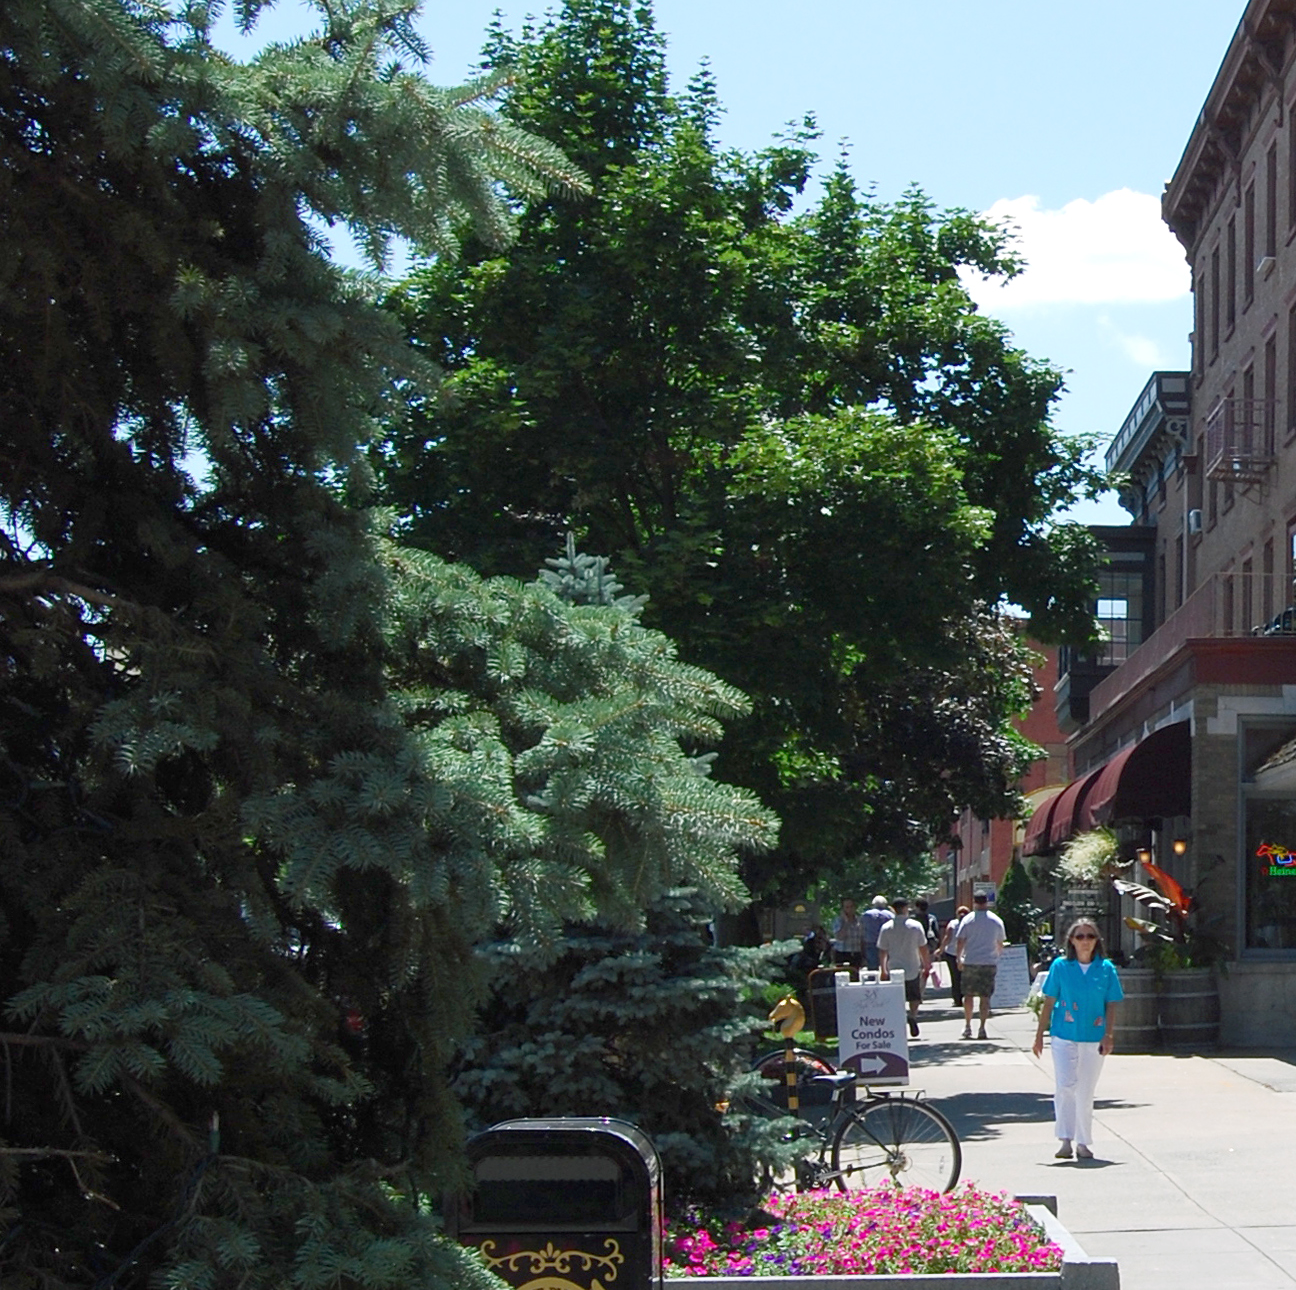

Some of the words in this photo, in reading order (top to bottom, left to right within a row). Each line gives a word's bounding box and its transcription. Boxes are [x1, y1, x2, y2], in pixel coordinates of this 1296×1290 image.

[860, 1016, 885, 1026] New
[851, 1029, 895, 1039] Condos
[872, 1041, 891, 1049] Sale
